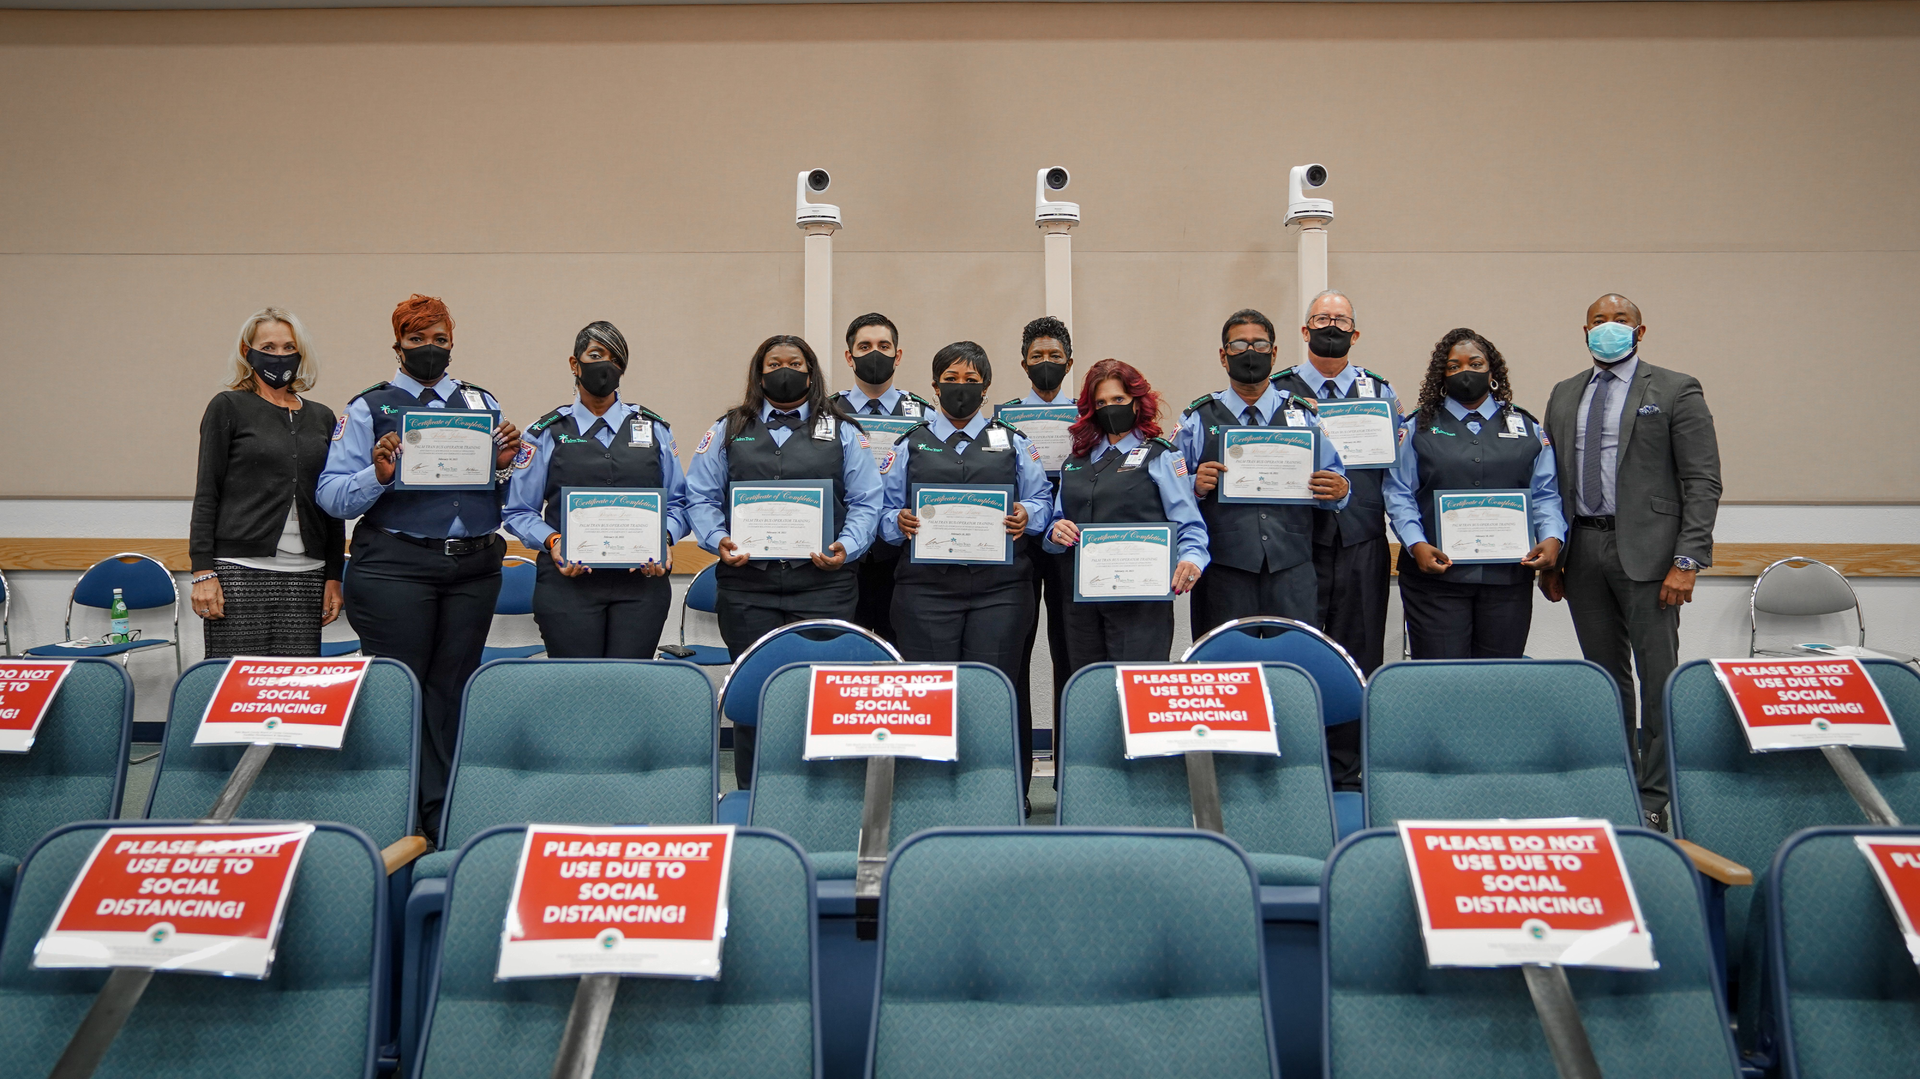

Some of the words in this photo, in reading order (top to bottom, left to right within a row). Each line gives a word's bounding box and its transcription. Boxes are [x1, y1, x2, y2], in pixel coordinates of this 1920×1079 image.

[1320, 408, 1346, 416] ertificate
[1352, 404, 1387, 416] Completion
[409, 417, 444, 427] Certificate
[445, 417, 453, 426] of
[453, 416, 489, 430] Completion
[1230, 435, 1264, 444] Certificate
[1265, 434, 1272, 443] of
[1273, 432, 1310, 446] Completion
[573, 498, 608, 507] Certificate
[618, 495, 656, 508] Completion
[738, 493, 772, 502] Certificate
[773, 492, 780, 501] of
[782, 491, 819, 504] Completion
[922, 495, 956, 504] Certificate
[958, 494, 965, 503] of
[965, 492, 1003, 507] Completion
[1445, 500, 1478, 508] Certificate
[1486, 496, 1522, 508] Completion
[1086, 534, 1120, 542] Certificate
[1128, 530, 1166, 542] Completion
[19, 670, 54, 679] NOT
[239, 666, 294, 674] PLEASE
[294, 666, 318, 675] DO
[320, 666, 354, 675] NOT
[1731, 666, 1788, 676] PLEASE
[1788, 666, 1816, 675] DO
[1818, 664, 1850, 674] NOT
[248, 677, 277, 686] USE
[826, 675, 880, 684] PLEASE
[884, 675, 907, 684] DO
[911, 675, 943, 684] NOT
[1133, 674, 1188, 684] PLEASE
[1191, 674, 1214, 683] DO
[1218, 672, 1250, 682] NOT
[1753, 678, 1786, 688] USE
[1787, 677, 1819, 688] DUE
[1819, 676, 1843, 686] TO
[9, 682, 30, 692] TO
[840, 687, 868, 697] USE
[872, 687, 903, 697] DUE
[1150, 686, 1179, 696] USE
[1182, 685, 1214, 696] DUE
[1216, 685, 1238, 695] TO
[257, 690, 311, 700] SOCIAL
[1777, 690, 1836, 701] SOCIAL
[230, 703, 327, 714] DISTANCING!
[855, 700, 911, 711] SOCIAL
[1168, 698, 1225, 709] SOCIAL
[1761, 703, 1865, 716] DISTANCING!
[832, 714, 931, 725] DISTANCING!
[1148, 710, 1248, 723] DISTANCING!
[115, 841, 196, 854] PLEASE
[1425, 836, 1506, 851] PLEASE
[1508, 836, 1545, 851] DO
[1548, 835, 1596, 851] NOT
[543, 842, 622, 857] PLEASE
[625, 842, 660, 858] DO
[664, 842, 713, 858] NOT
[126, 859, 169, 874] USE
[172, 859, 220, 874] DUE
[224, 859, 254, 874] TO
[1452, 855, 1497, 870] USE
[1499, 855, 1548, 870] DUE
[1548, 855, 1582, 871] TO
[560, 861, 602, 878] USE
[605, 862, 652, 879] DUE
[655, 862, 686, 879] TO
[138, 878, 220, 895] SOCIAL
[1482, 875, 1566, 892] SOCIAL
[578, 883, 659, 900] SOCIAL
[96, 899, 245, 919] DISTANCING!
[1455, 896, 1604, 915] DISTANCING!
[543, 905, 686, 923] DISTANCING!
